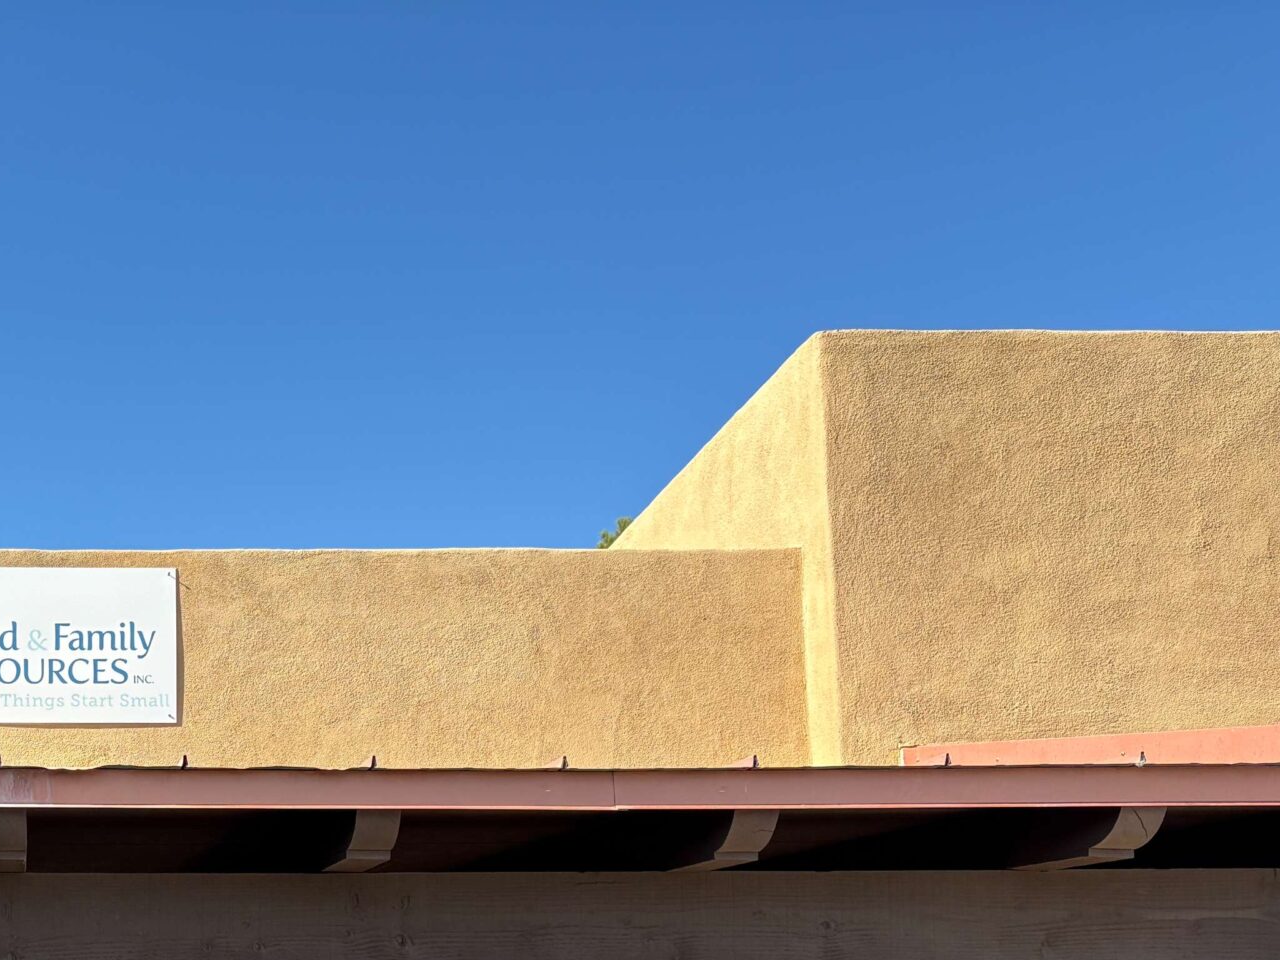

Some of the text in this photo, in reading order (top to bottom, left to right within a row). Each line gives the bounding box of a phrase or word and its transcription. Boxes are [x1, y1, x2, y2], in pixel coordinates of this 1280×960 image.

[27, 629, 48, 651] &
[54, 621, 156, 658] Family
[0, 693, 65, 711] Things
[70, 693, 114, 708] Start
[119, 693, 170, 708] Small
